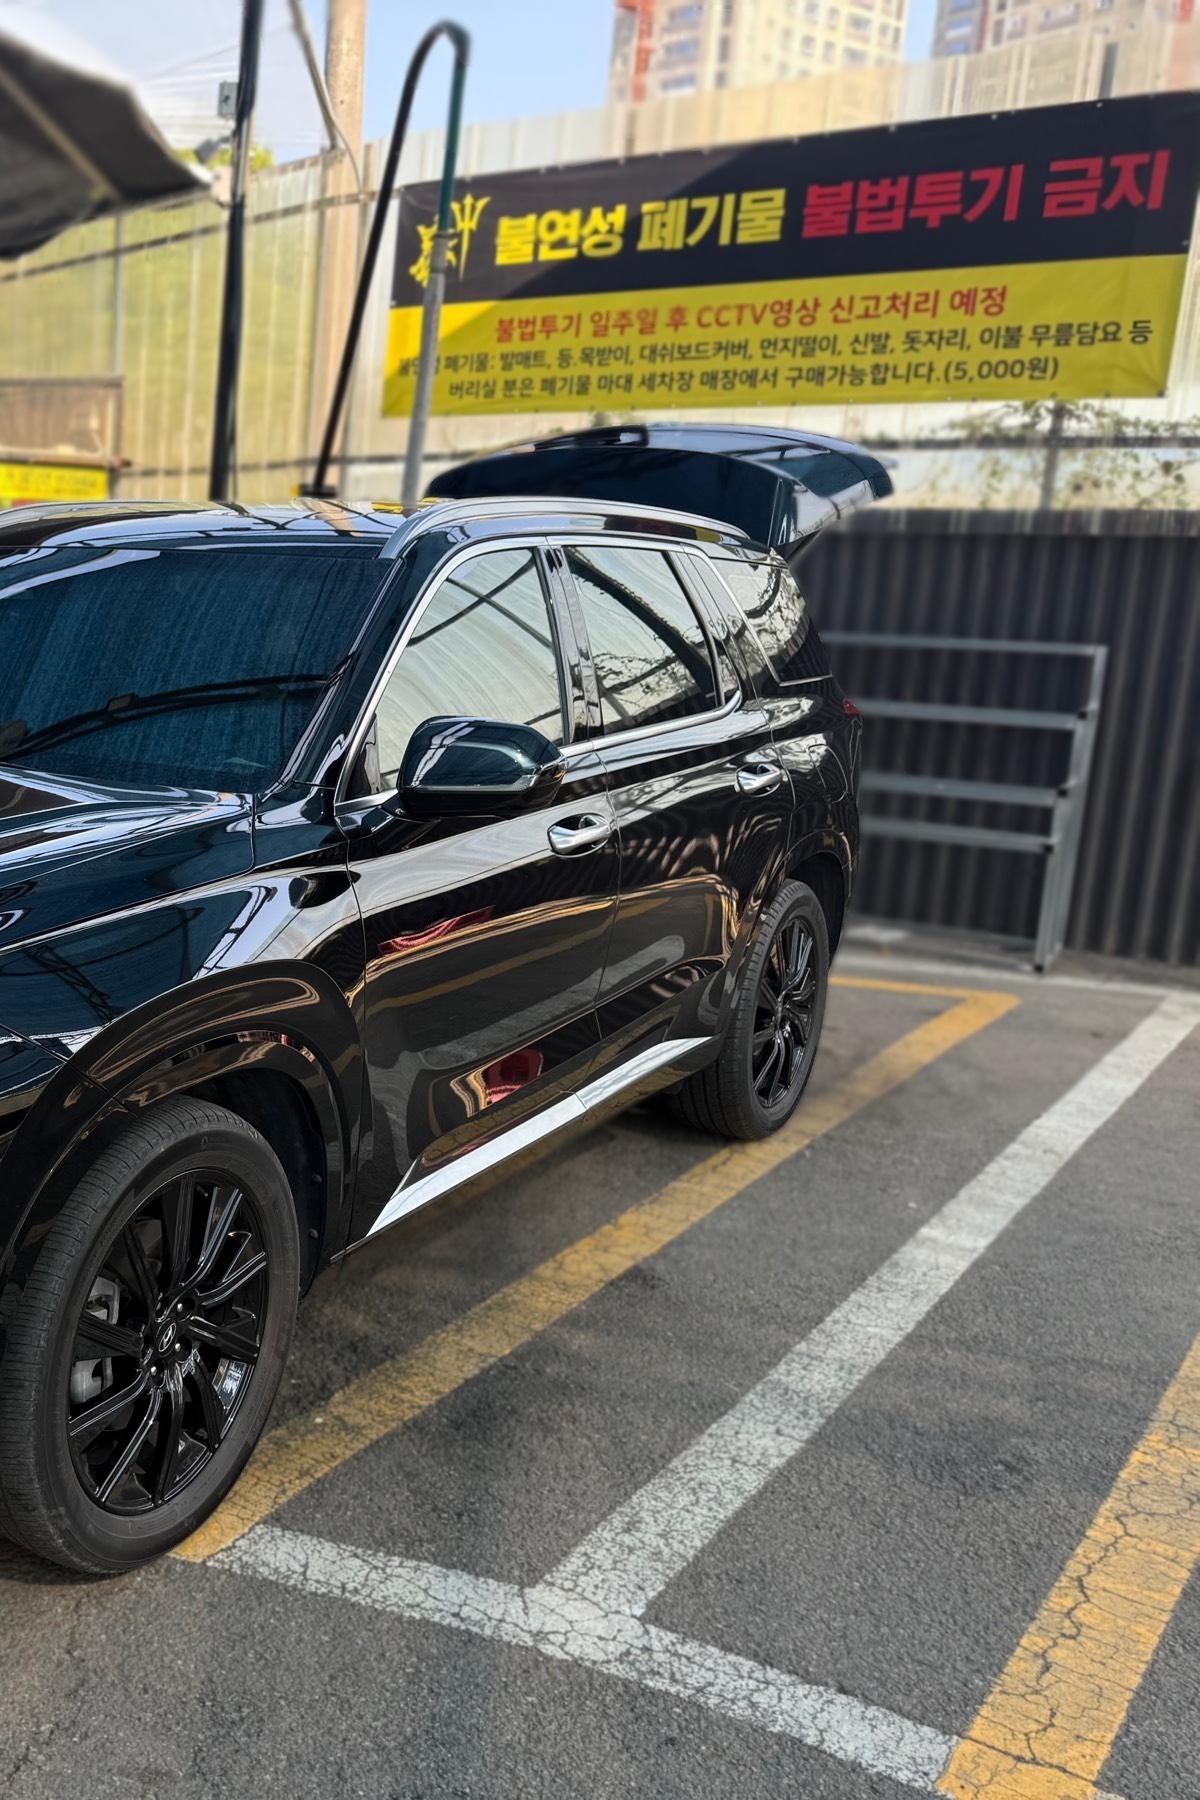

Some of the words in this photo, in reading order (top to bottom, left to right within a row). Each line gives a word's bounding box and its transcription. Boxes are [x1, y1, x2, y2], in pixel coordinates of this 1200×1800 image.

[495, 204, 627, 266] 불연성
[636, 188, 786, 251] 폐기물
[801, 164, 1024, 239] 불법투기
[1042, 149, 1171, 219] 금지
[495, 312, 582, 344] 불법투기
[590, 306, 659, 338] 일주일
[665, 304, 689, 333] 후
[696, 296, 822, 329] CCTV영상
[829, 288, 940, 325] 신고처리
[949, 285, 1008, 317] 예정
[849, 331, 895, 355] 신발,
[979, 324, 1024, 350] 이불
[1028, 320, 1122, 348] 무릎담요
[1128, 319, 1153, 345] 등
[449, 378, 497, 399] 버리실
[502, 377, 535, 398] 분은
[540, 374, 591, 396] 폐기물
[597, 373, 633, 394] 마대
[638, 370, 695, 393] 세차장
[699, 367, 779, 391] 매장에서
